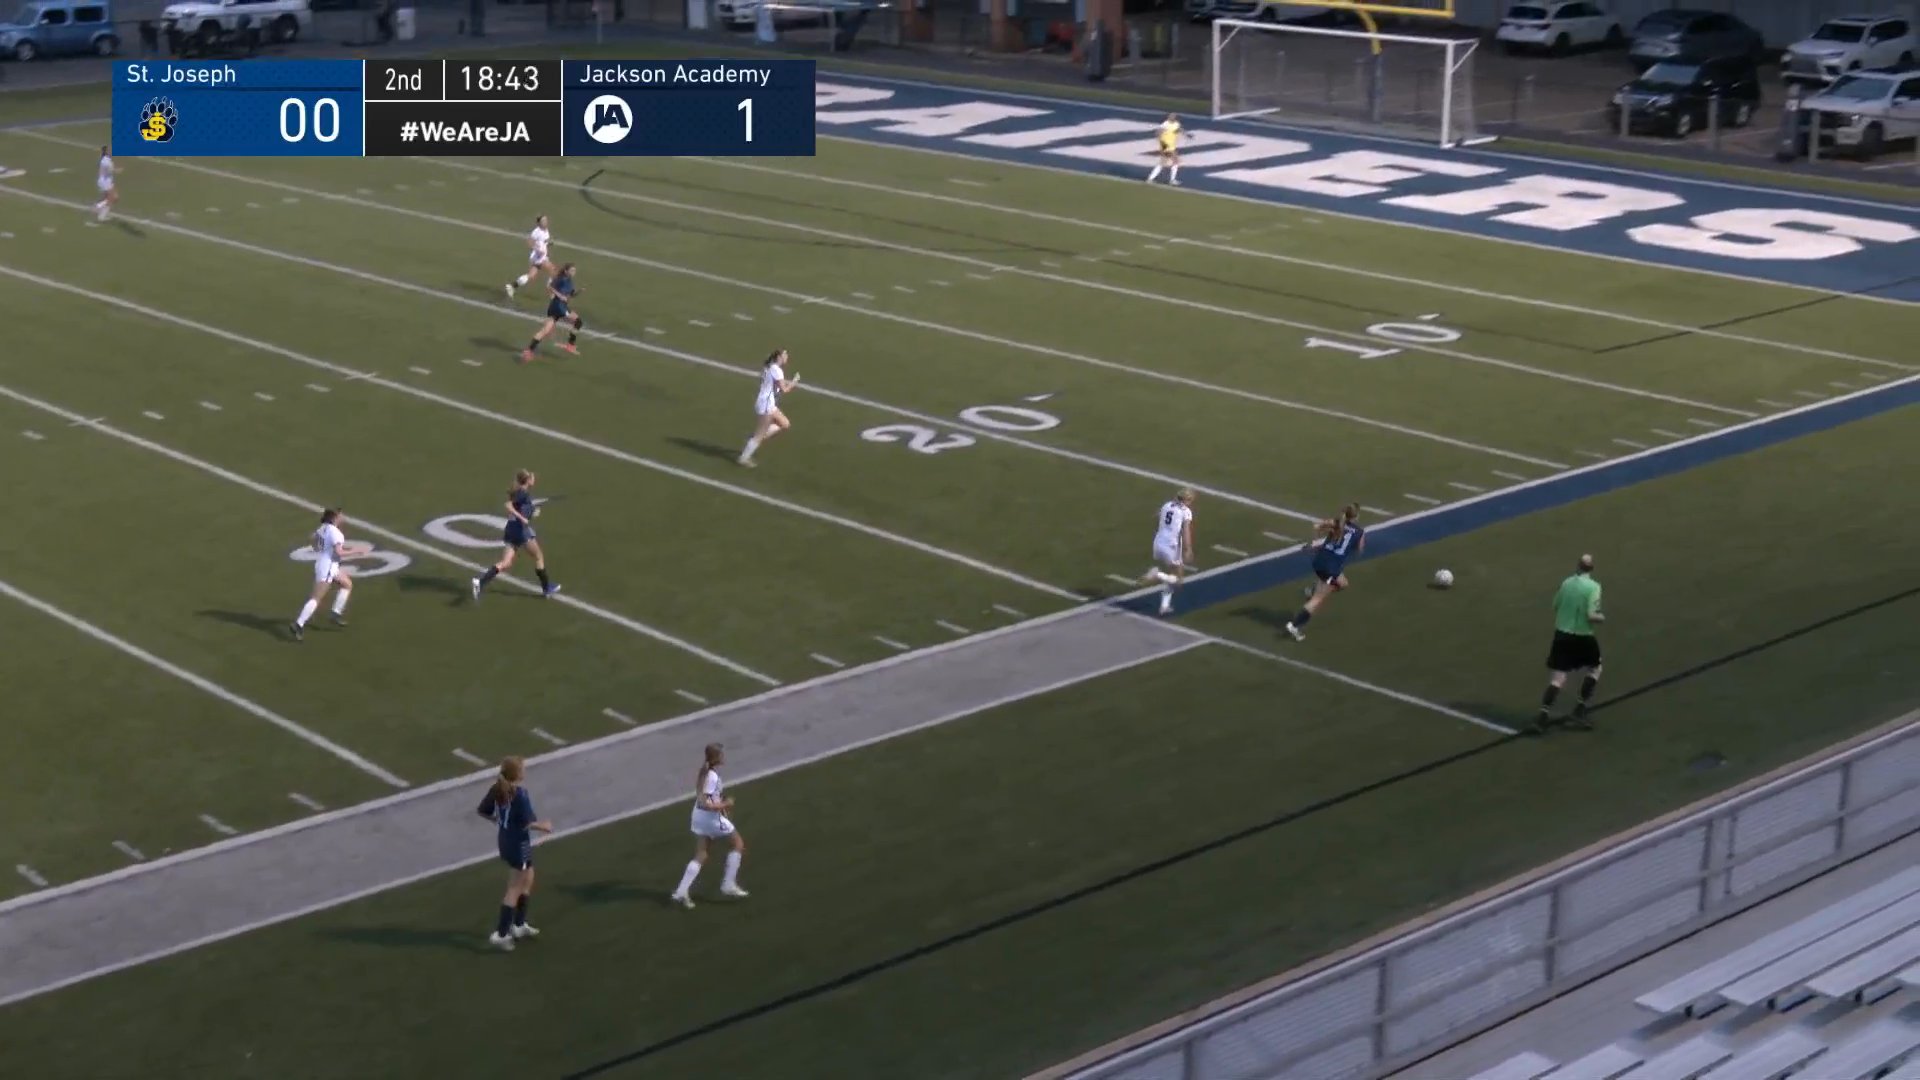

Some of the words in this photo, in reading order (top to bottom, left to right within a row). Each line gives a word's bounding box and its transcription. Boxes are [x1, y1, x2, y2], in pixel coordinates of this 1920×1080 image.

[1304, 322, 1462, 359] 10
[860, 405, 1061, 454] 20
[1165, 511, 1174, 525] 5
